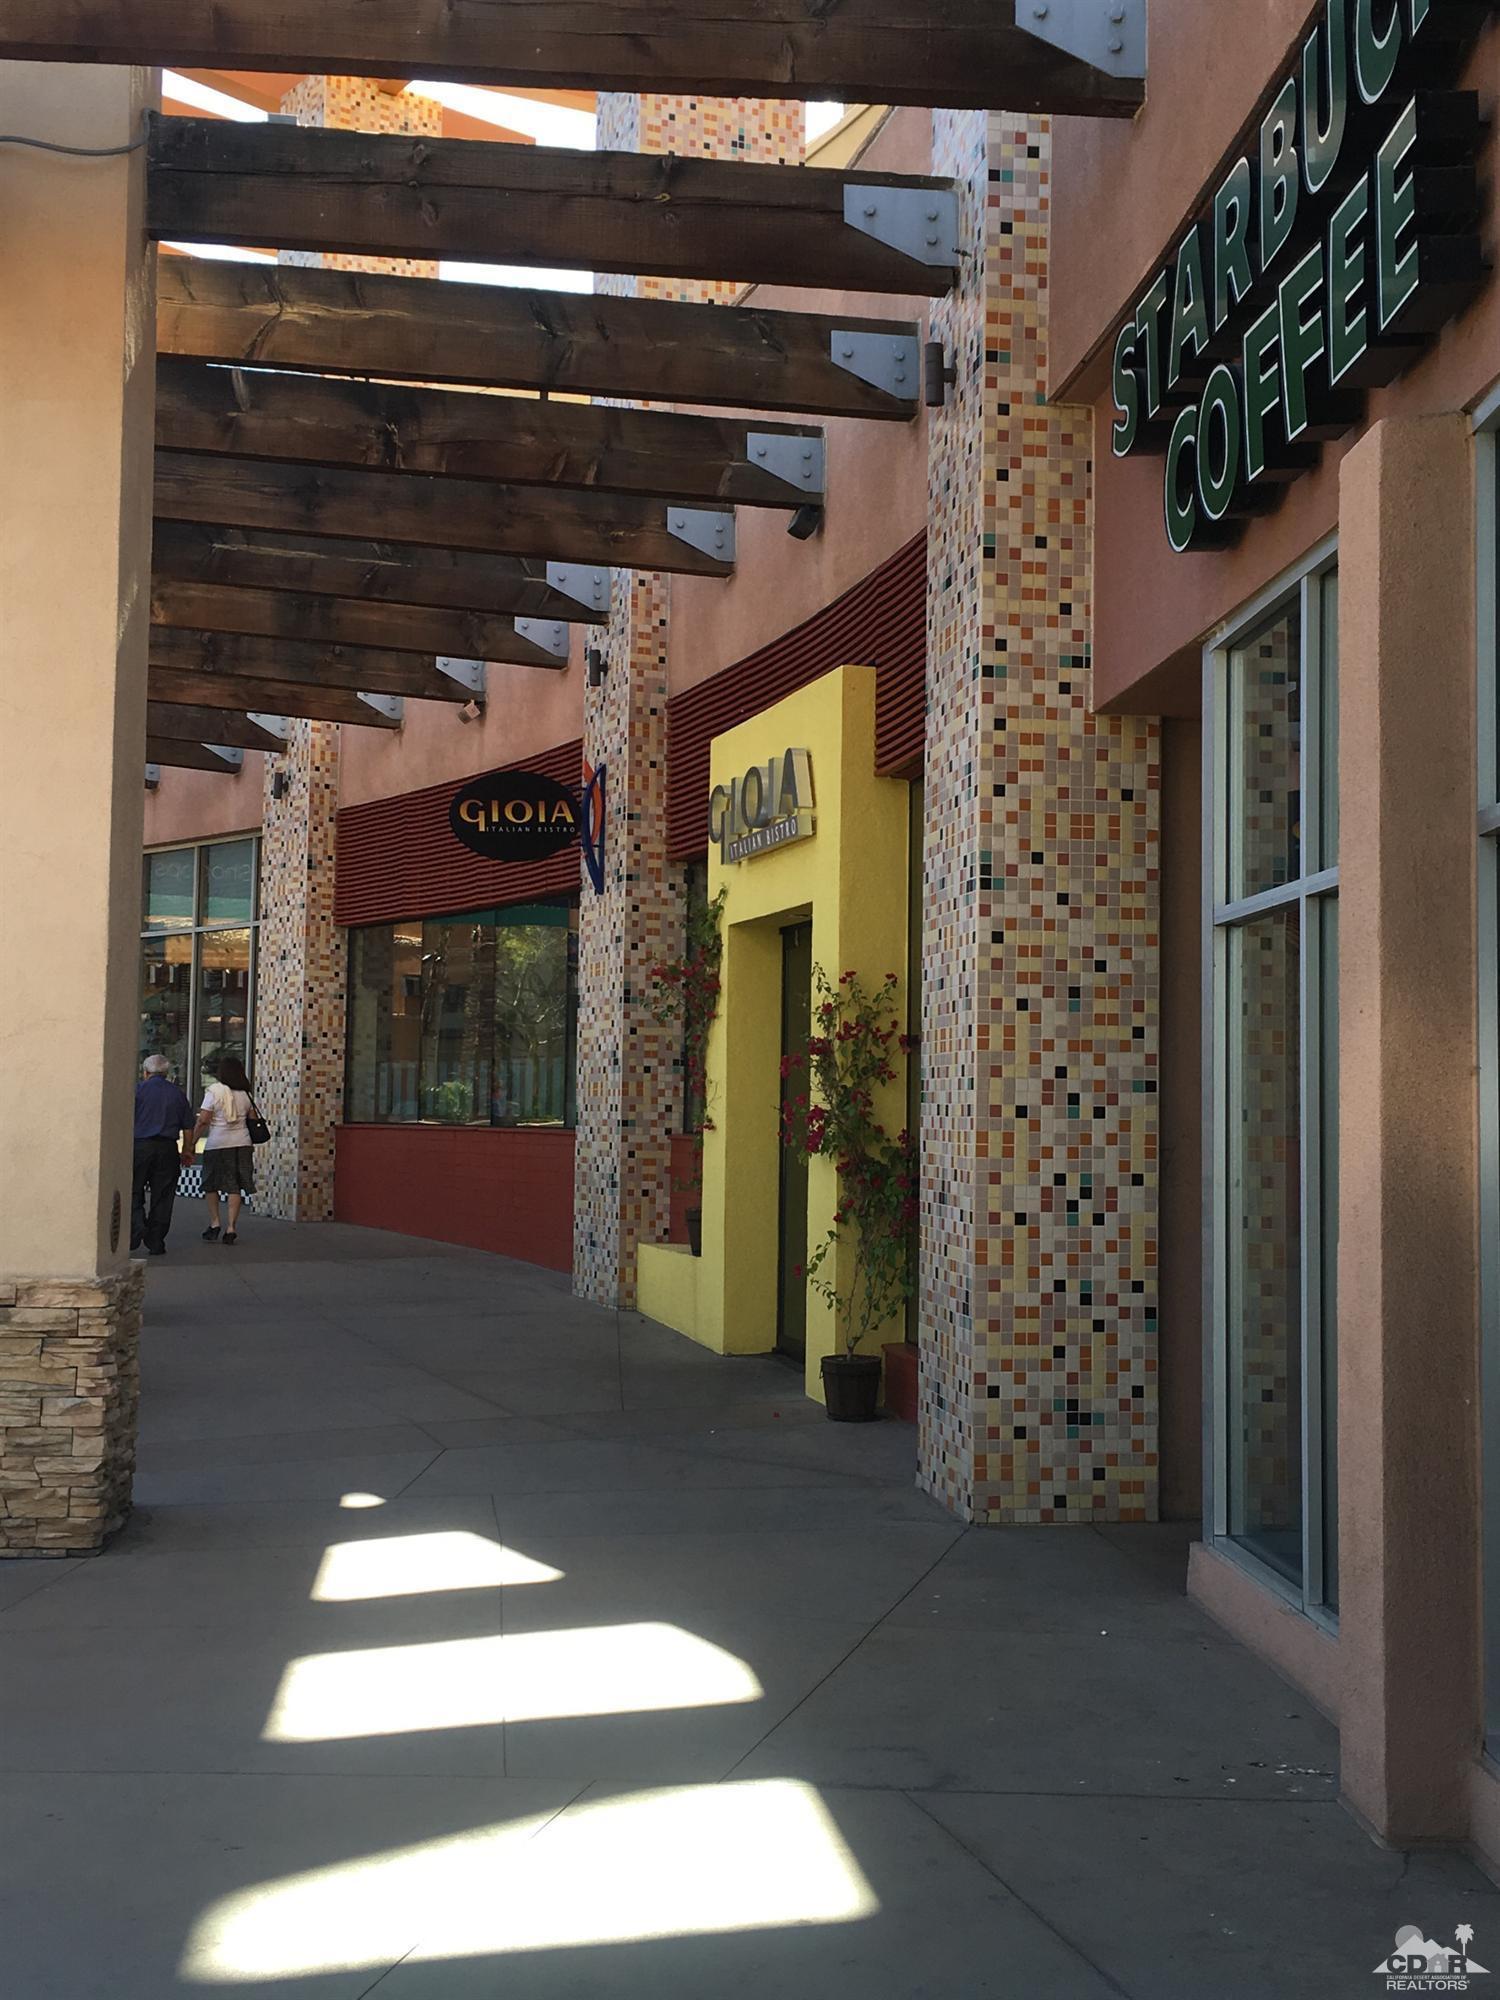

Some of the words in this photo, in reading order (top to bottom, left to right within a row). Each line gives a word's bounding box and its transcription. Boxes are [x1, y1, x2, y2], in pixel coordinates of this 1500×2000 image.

[1164, 95, 1420, 553] COFFEE
[459, 799, 575, 832] GIOIA
[708, 747, 810, 865] GIOIA
[730, 834, 762, 860] ITALIAN
[766, 818, 798, 845] BISTRO
